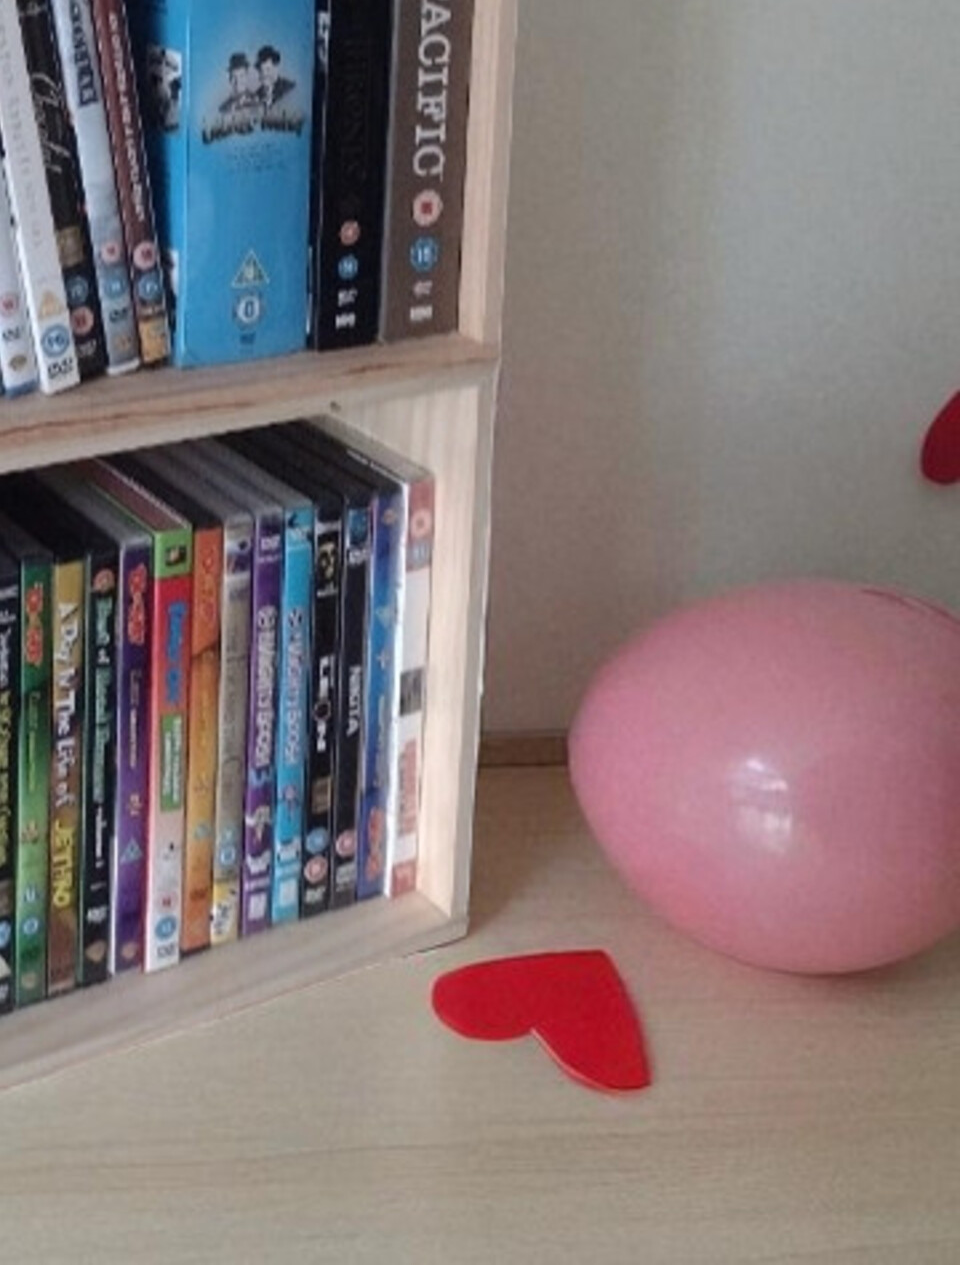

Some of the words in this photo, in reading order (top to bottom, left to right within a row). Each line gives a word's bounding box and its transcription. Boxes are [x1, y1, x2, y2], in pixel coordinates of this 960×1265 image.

[55, 689, 77, 736] The
[346, 664, 363, 738] NIKITA
[52, 819, 76, 907] JETHRO
